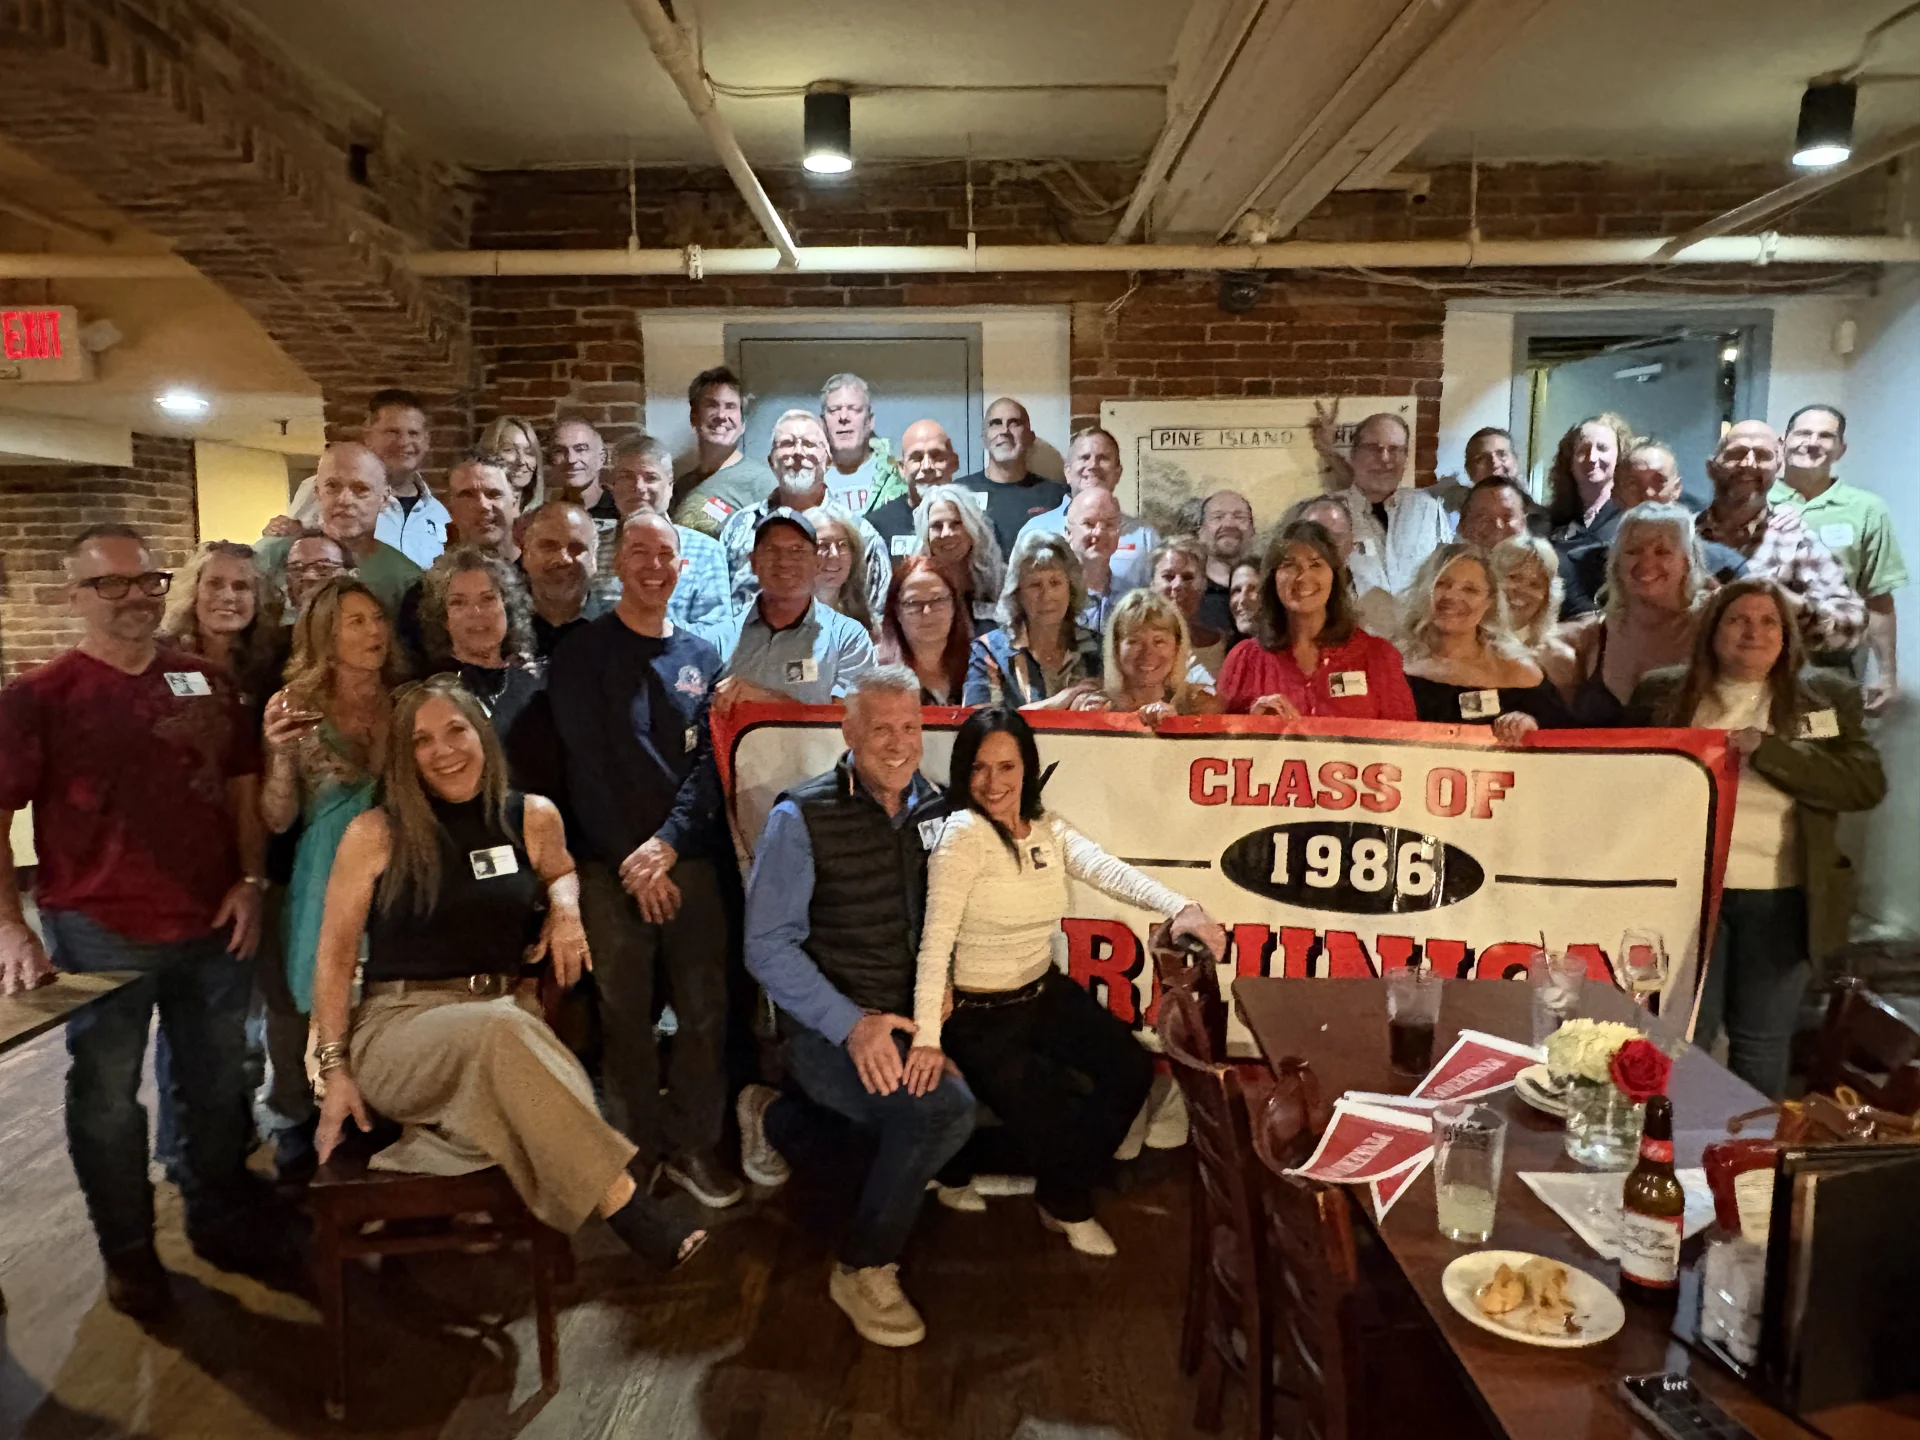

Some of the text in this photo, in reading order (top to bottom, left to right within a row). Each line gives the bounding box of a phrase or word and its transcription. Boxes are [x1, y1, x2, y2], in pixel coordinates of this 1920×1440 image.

[1, 311, 62, 359] EXIT
[1160, 430, 1294, 446] PINE ISLAND
[1189, 757, 1515, 818] CLASS OF
[1271, 831, 1438, 897] 1986
